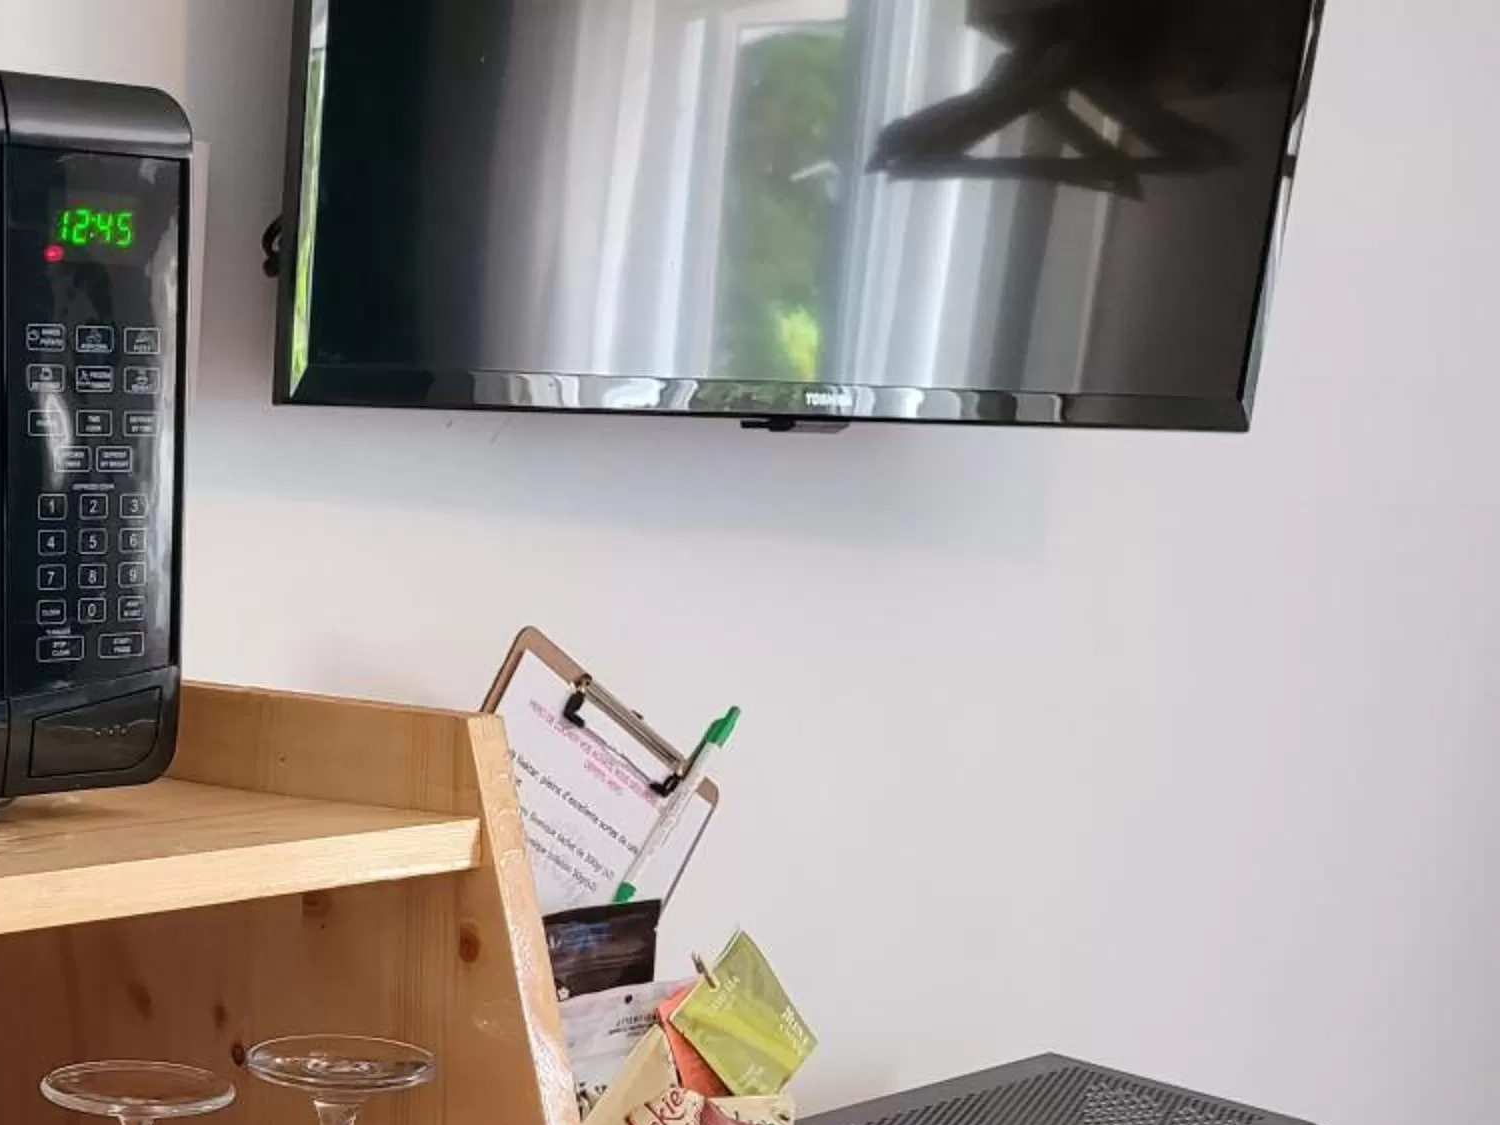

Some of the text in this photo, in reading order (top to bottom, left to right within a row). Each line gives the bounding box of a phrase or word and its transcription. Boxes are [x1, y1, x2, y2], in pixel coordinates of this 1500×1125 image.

[58, 208, 133, 246] 12:45
[49, 500, 56, 513] 1
[90, 499, 98, 514] 2
[131, 499, 139, 513] 3
[47, 536, 55, 549] 4
[89, 535, 97, 549] 5
[129, 534, 137, 547] 6
[47, 571, 55, 585] 7
[89, 570, 97, 584] 8
[129, 569, 137, 583] 9
[88, 604, 96, 617] 0
